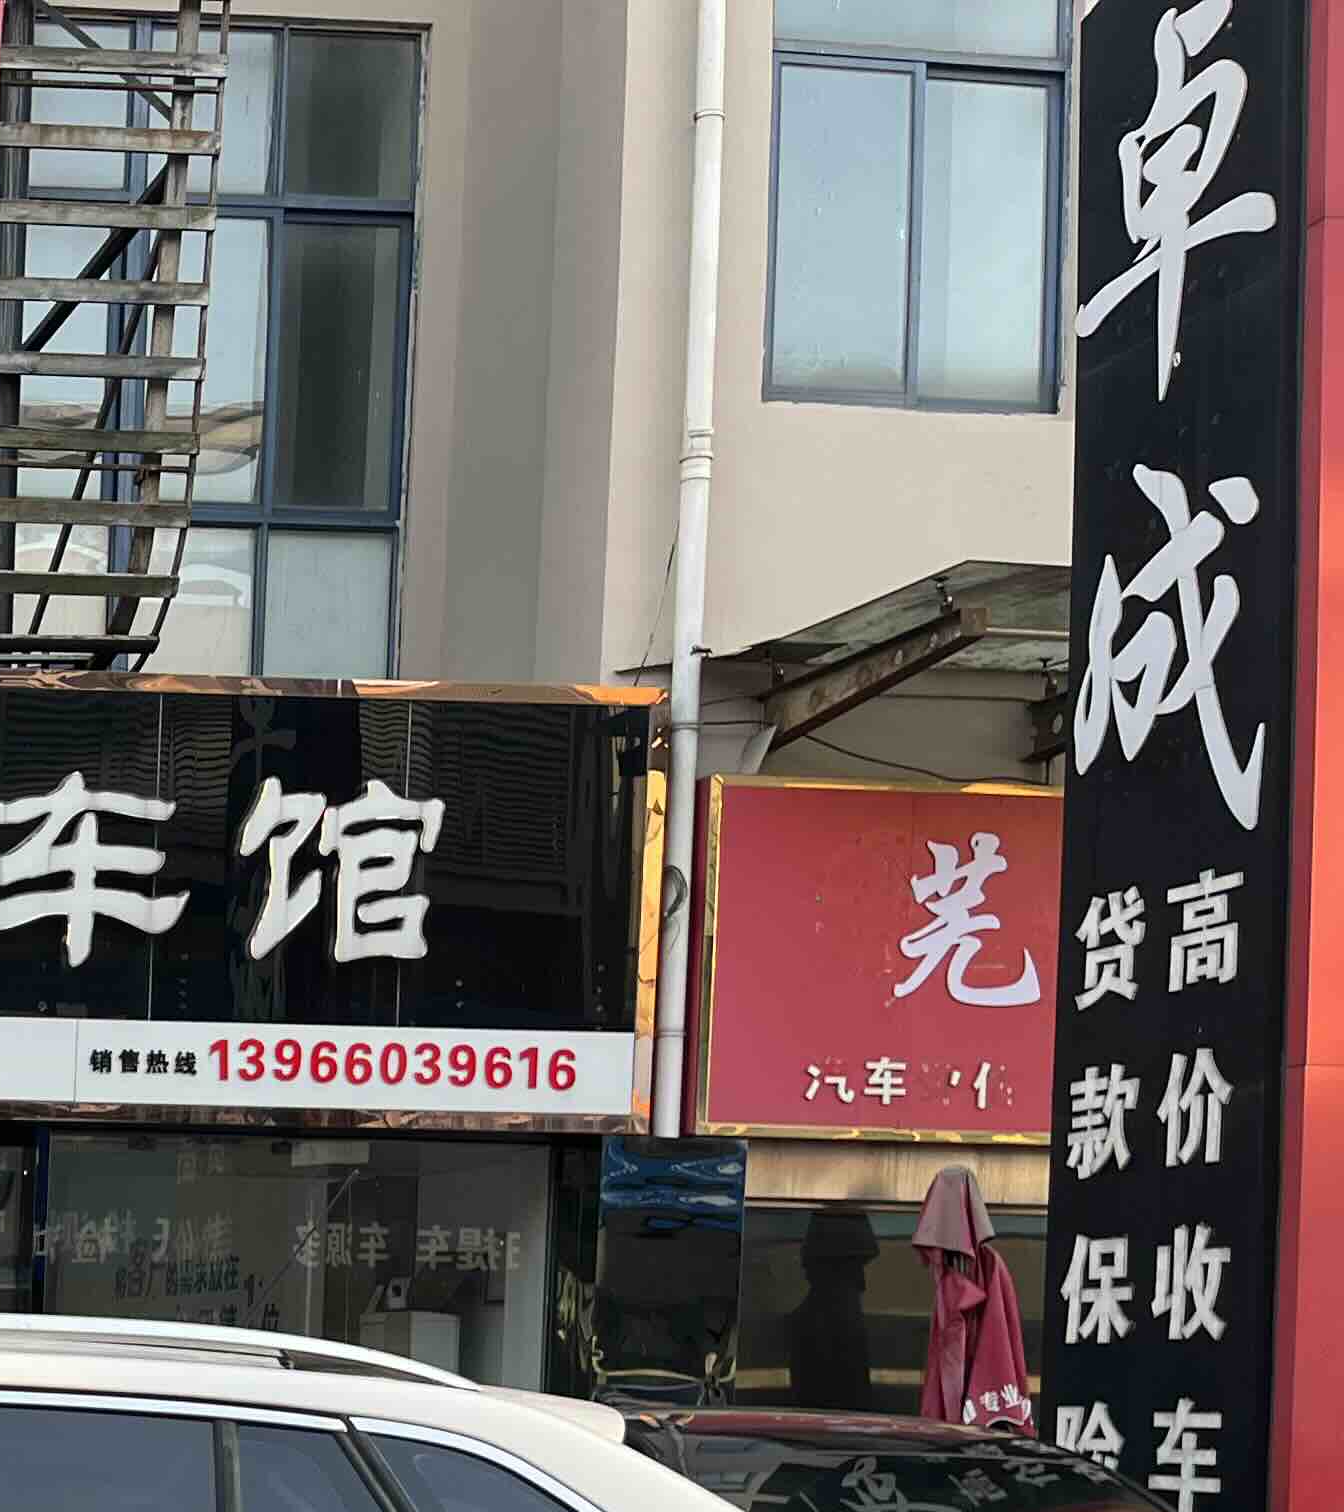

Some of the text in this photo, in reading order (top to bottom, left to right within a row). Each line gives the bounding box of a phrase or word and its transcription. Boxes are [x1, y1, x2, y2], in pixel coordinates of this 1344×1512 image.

[1075, 0, 1277, 831] 卓成
[88, 1037, 578, 1092] 销售热线 13966039616
